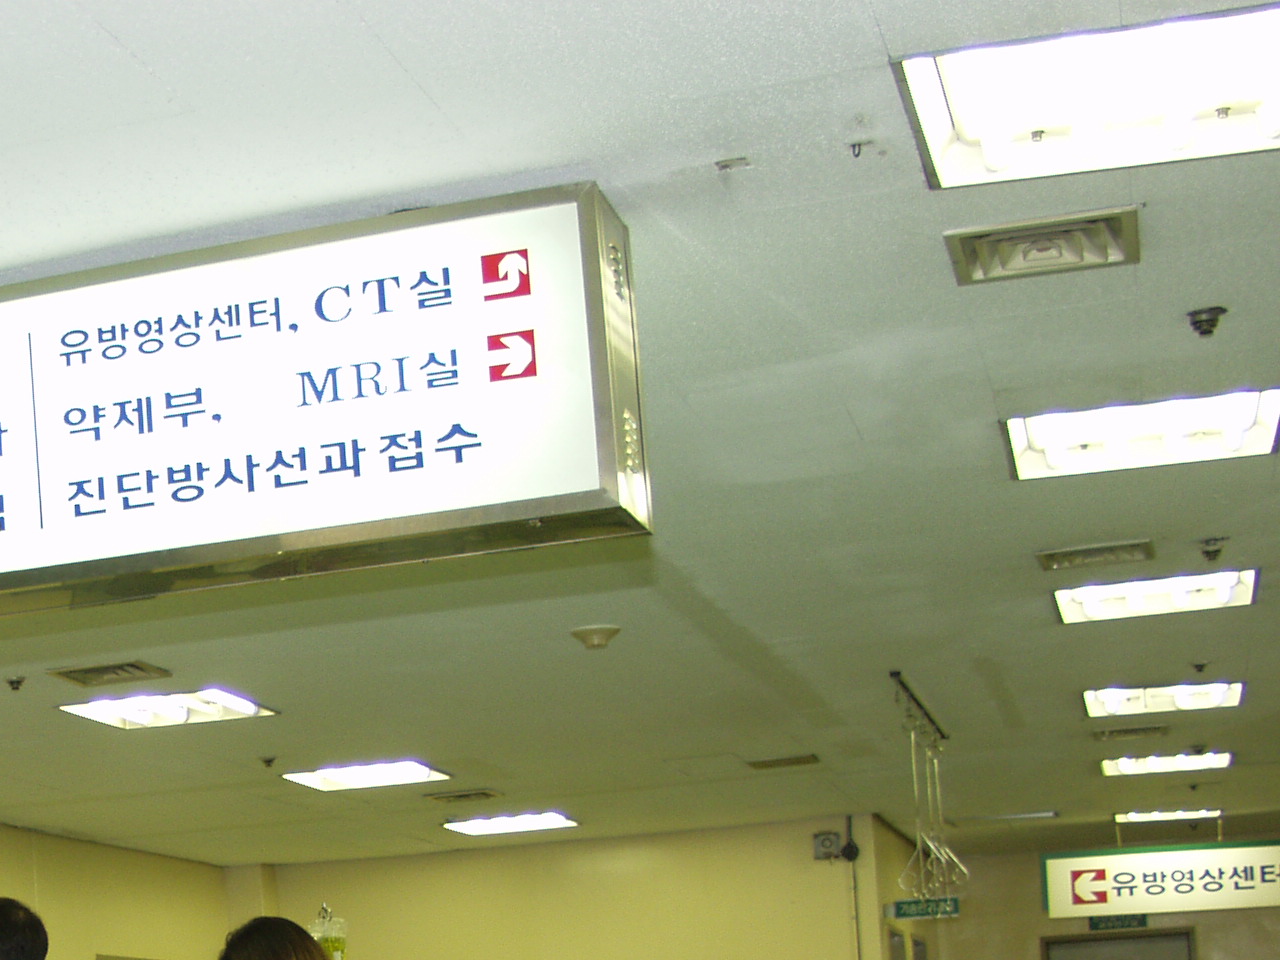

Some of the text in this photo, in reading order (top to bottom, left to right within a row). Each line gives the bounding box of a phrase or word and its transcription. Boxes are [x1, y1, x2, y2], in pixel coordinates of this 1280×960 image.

[59, 266, 454, 366] 유방영상센터, CT실
[63, 349, 460, 441] 약제부, MRI실
